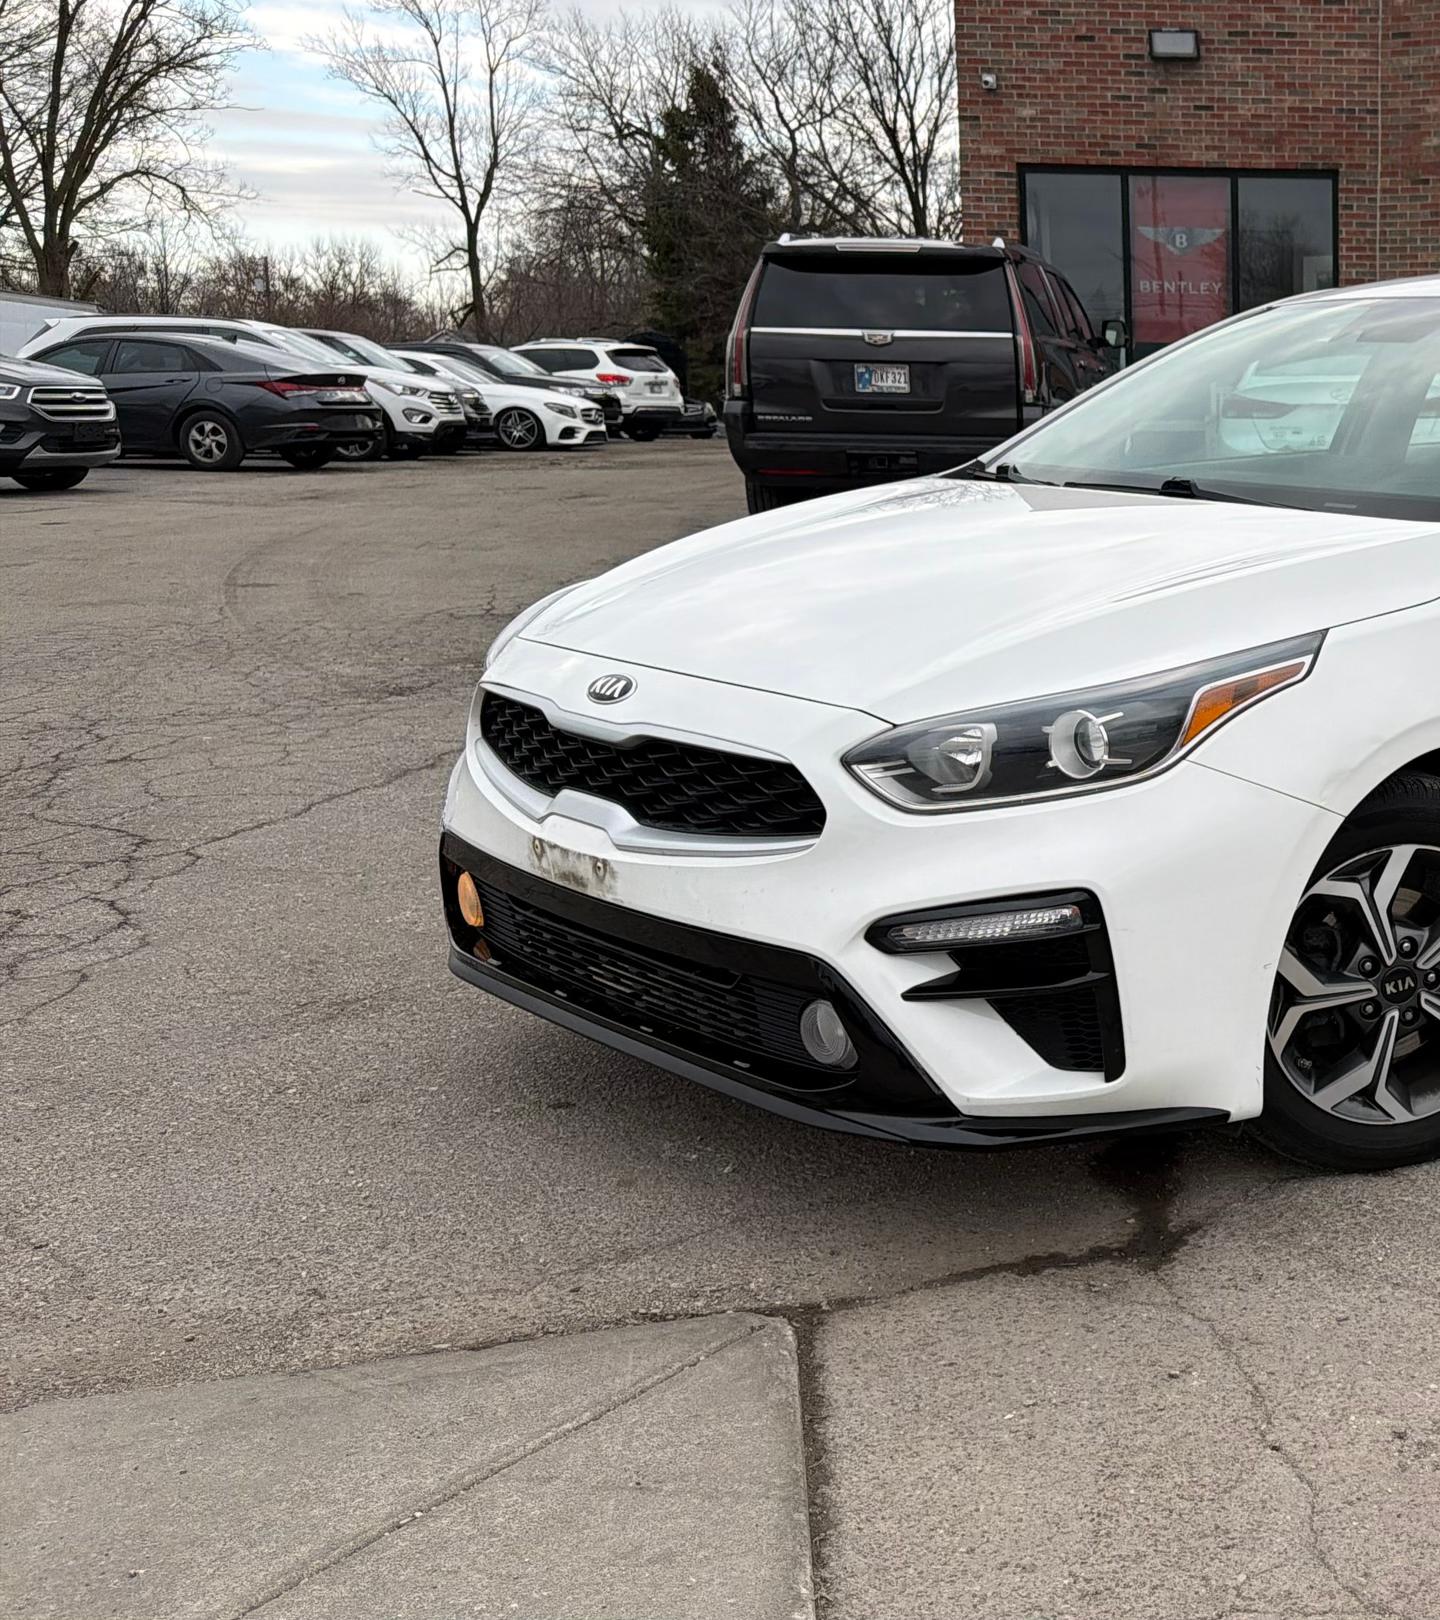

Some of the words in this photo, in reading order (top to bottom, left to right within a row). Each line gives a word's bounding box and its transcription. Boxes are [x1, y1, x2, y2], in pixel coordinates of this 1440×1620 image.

[1176, 234, 1188, 248] B
[1140, 281, 1222, 295] BENTLEY
[590, 677, 628, 698] KIA
[1385, 976, 1415, 995] KIA
